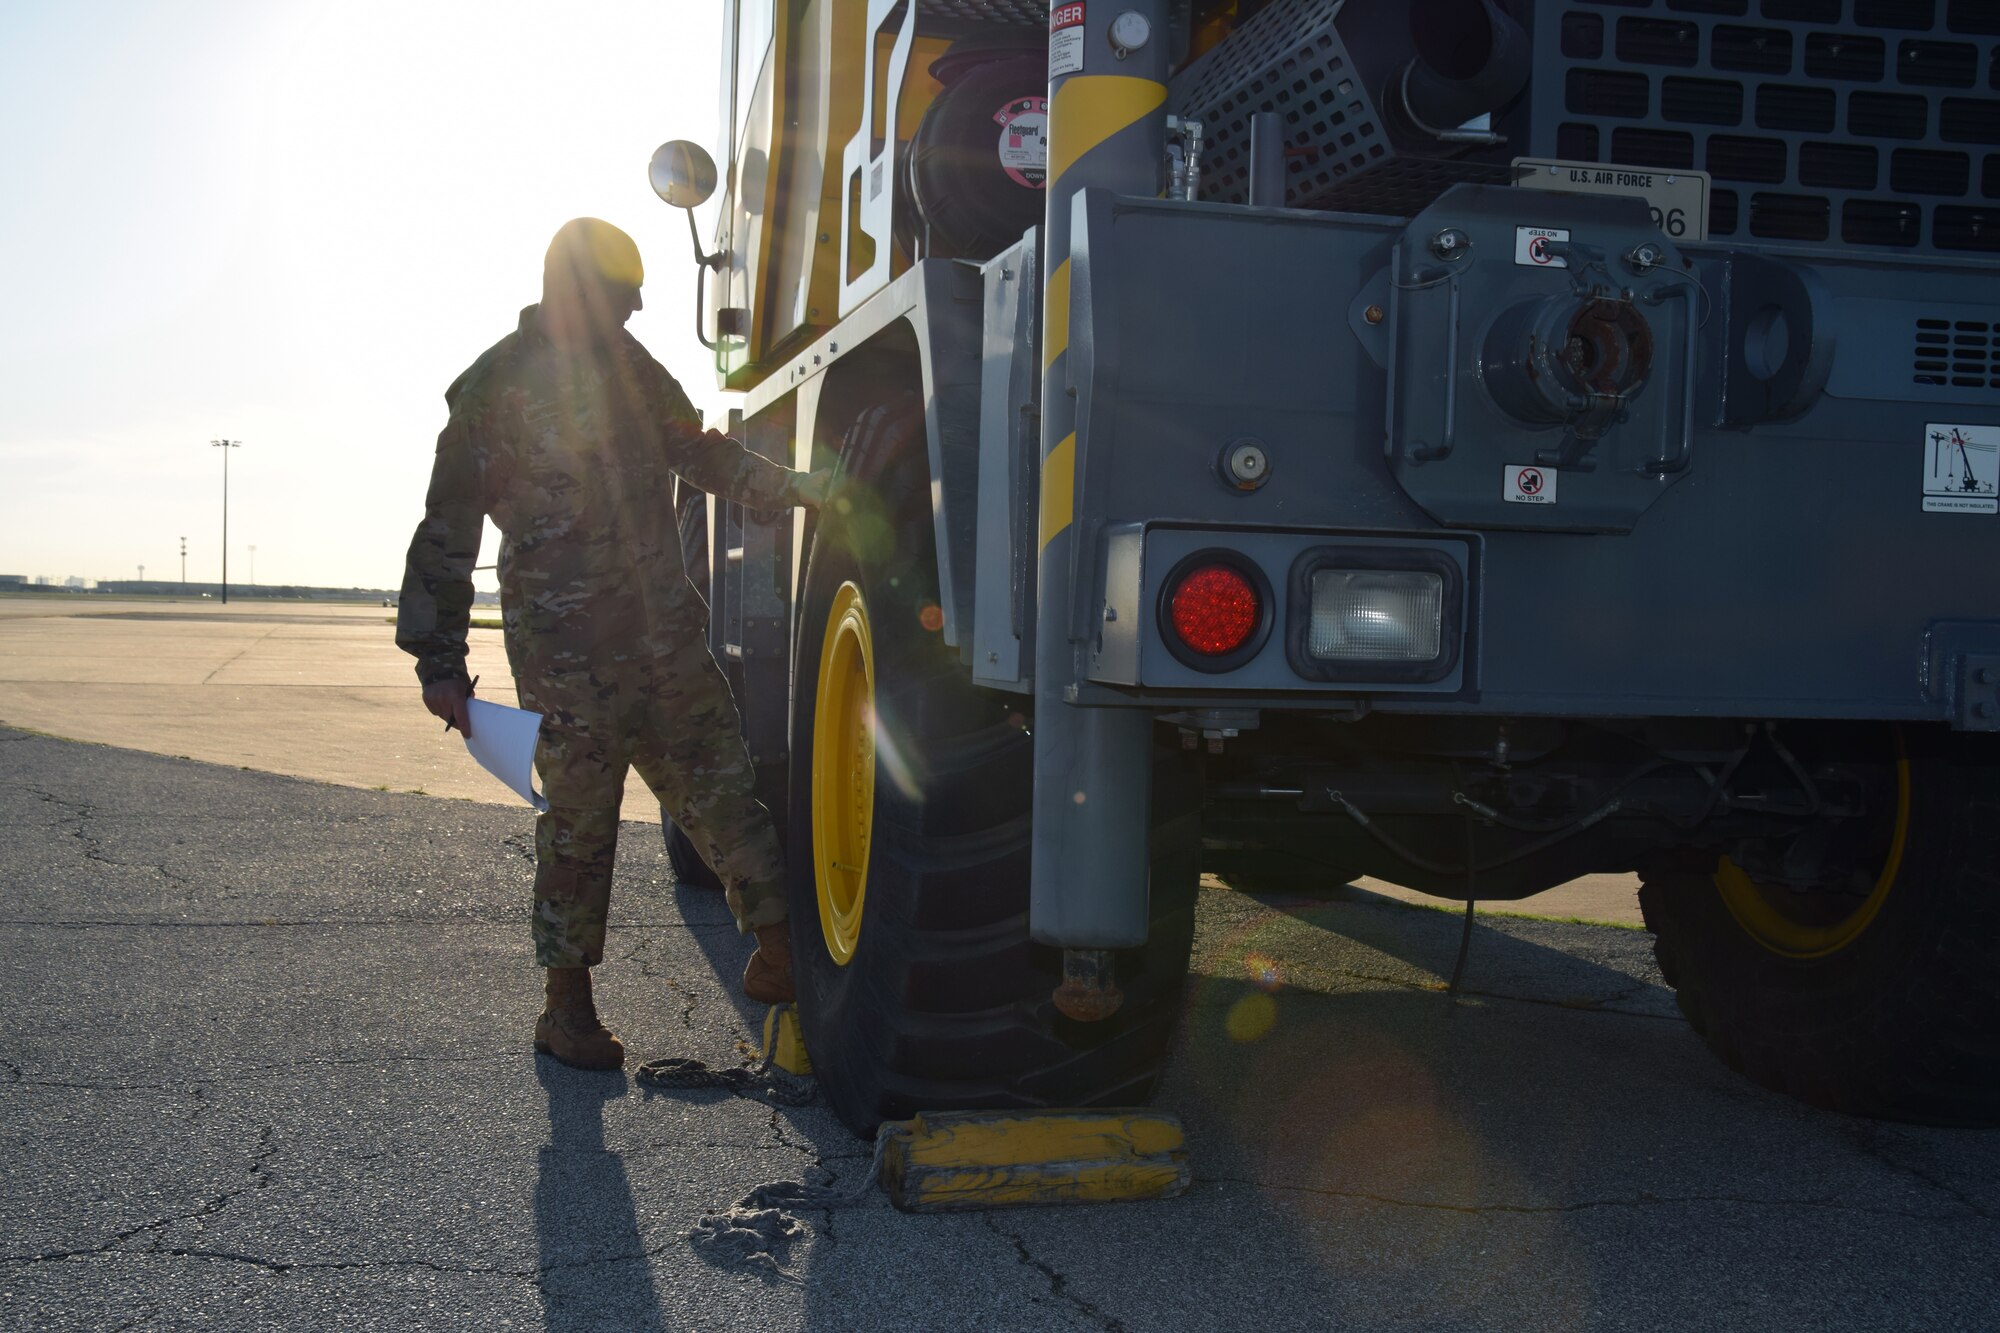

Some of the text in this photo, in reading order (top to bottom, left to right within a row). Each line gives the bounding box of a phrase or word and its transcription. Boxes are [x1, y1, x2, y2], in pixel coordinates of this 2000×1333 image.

[1009, 124, 1039, 137] Fleetguard
[1570, 170, 1652, 188] U.S. AIR FORCE
[1547, 230, 1558, 238] NO
